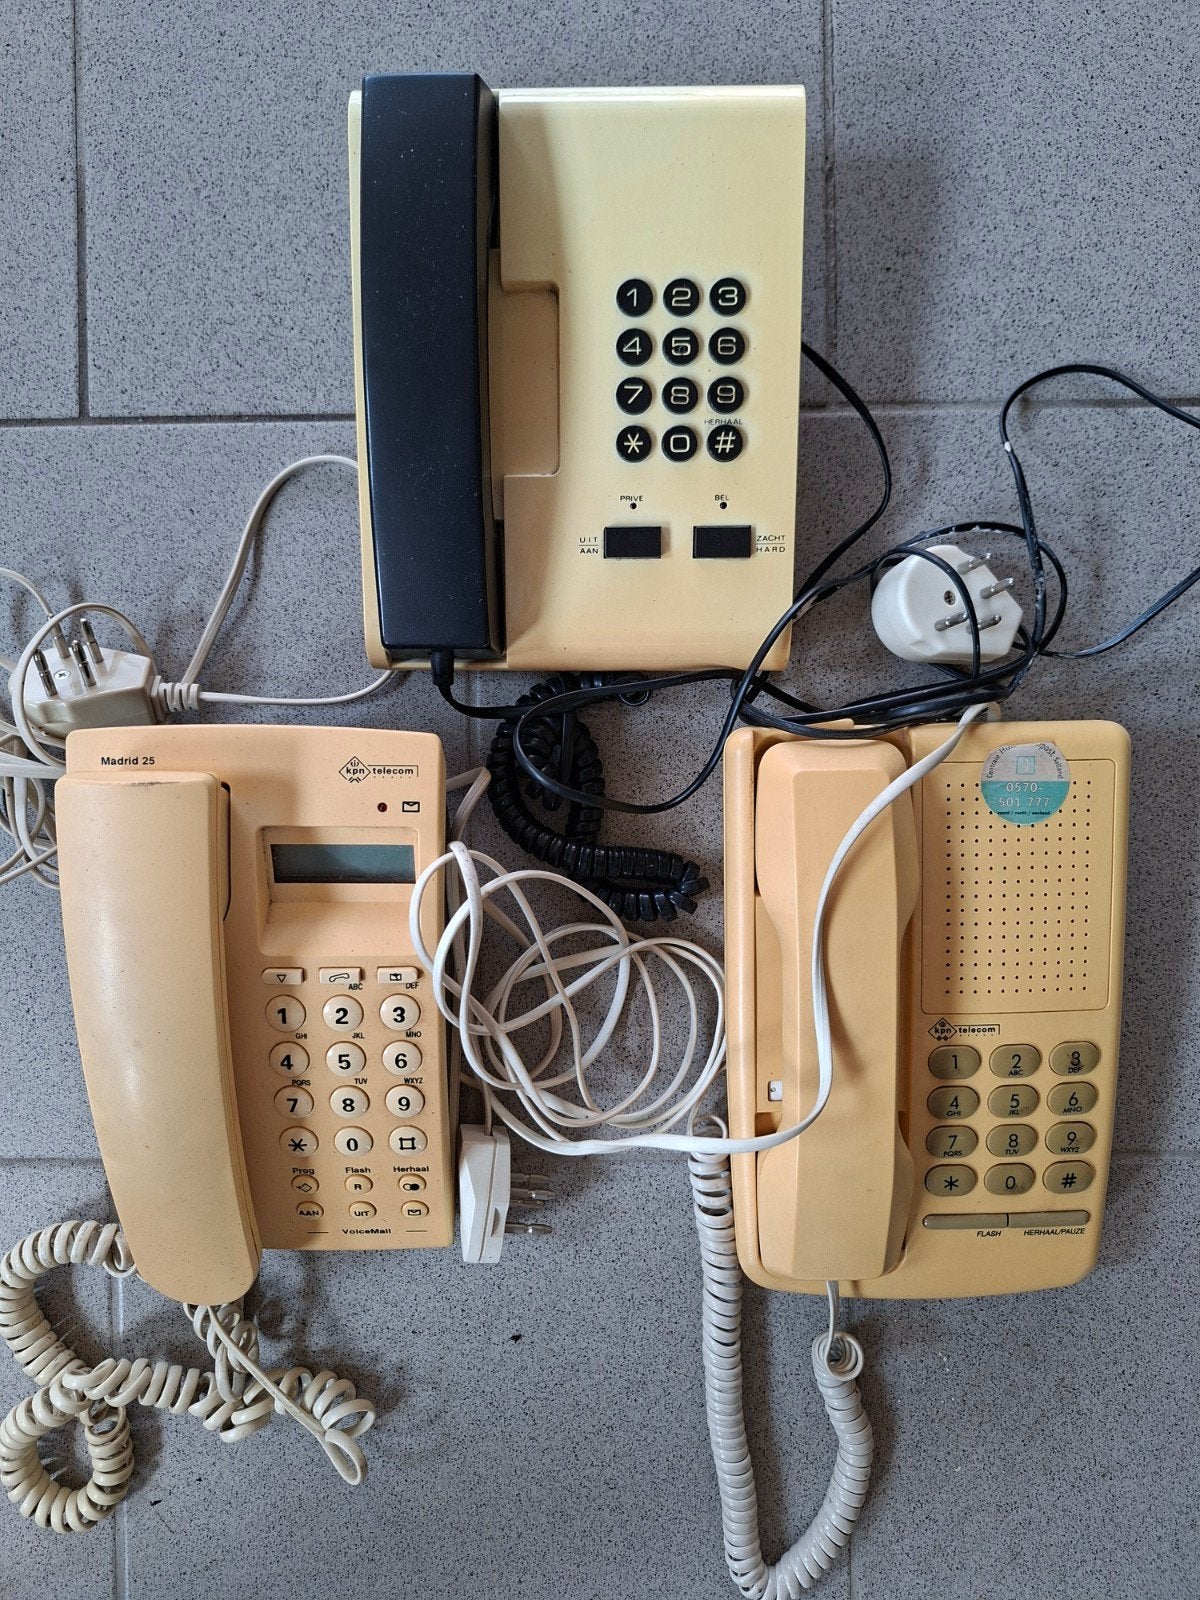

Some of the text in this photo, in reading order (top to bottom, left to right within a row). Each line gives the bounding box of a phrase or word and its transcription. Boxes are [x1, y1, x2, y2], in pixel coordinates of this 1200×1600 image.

[626, 288, 638, 307] 1
[671, 287, 692, 307] 2
[718, 287, 738, 306] 3
[622, 336, 642, 356] 4
[671, 337, 691, 356] 5
[717, 336, 736, 355] 6
[623, 385, 643, 404] 7
[670, 386, 690, 405] 8
[716, 385, 736, 404] 9
[704, 418, 742, 426] HERHAAL
[101, 757, 155, 766] Madrid 25
[346, 766, 414, 776] kpn telecom
[1007, 783, 1042, 792] 0570-
[999, 798, 1050, 806] 501 777
[348, 983, 363, 991] ABC
[277, 1008, 287, 1024] 1
[335, 1008, 349, 1025] 2
[393, 1007, 406, 1023] 3
[935, 1027, 952, 1036] kpn
[280, 1054, 293, 1070] 4
[338, 1054, 351, 1070] 5
[395, 1053, 408, 1069] 6
[952, 1055, 958, 1069] 1
[1012, 1054, 1021, 1069] 2
[287, 1098, 298, 1112] 7
[342, 1098, 355, 1112] 8
[398, 1096, 411, 1111] 9
[950, 1095, 959, 1110] 4
[1010, 1094, 1020, 1108] 5
[1069, 1092, 1079, 1106] 6
[949, 1135, 958, 1149] 7
[1009, 1134, 1018, 1148] 8
[1067, 1132, 1077, 1145] 9
[292, 1167, 315, 1175] Prog
[1006, 1176, 1016, 1190] 0
[1024, 1228, 1085, 1236] HERHAAL/PAUZE
